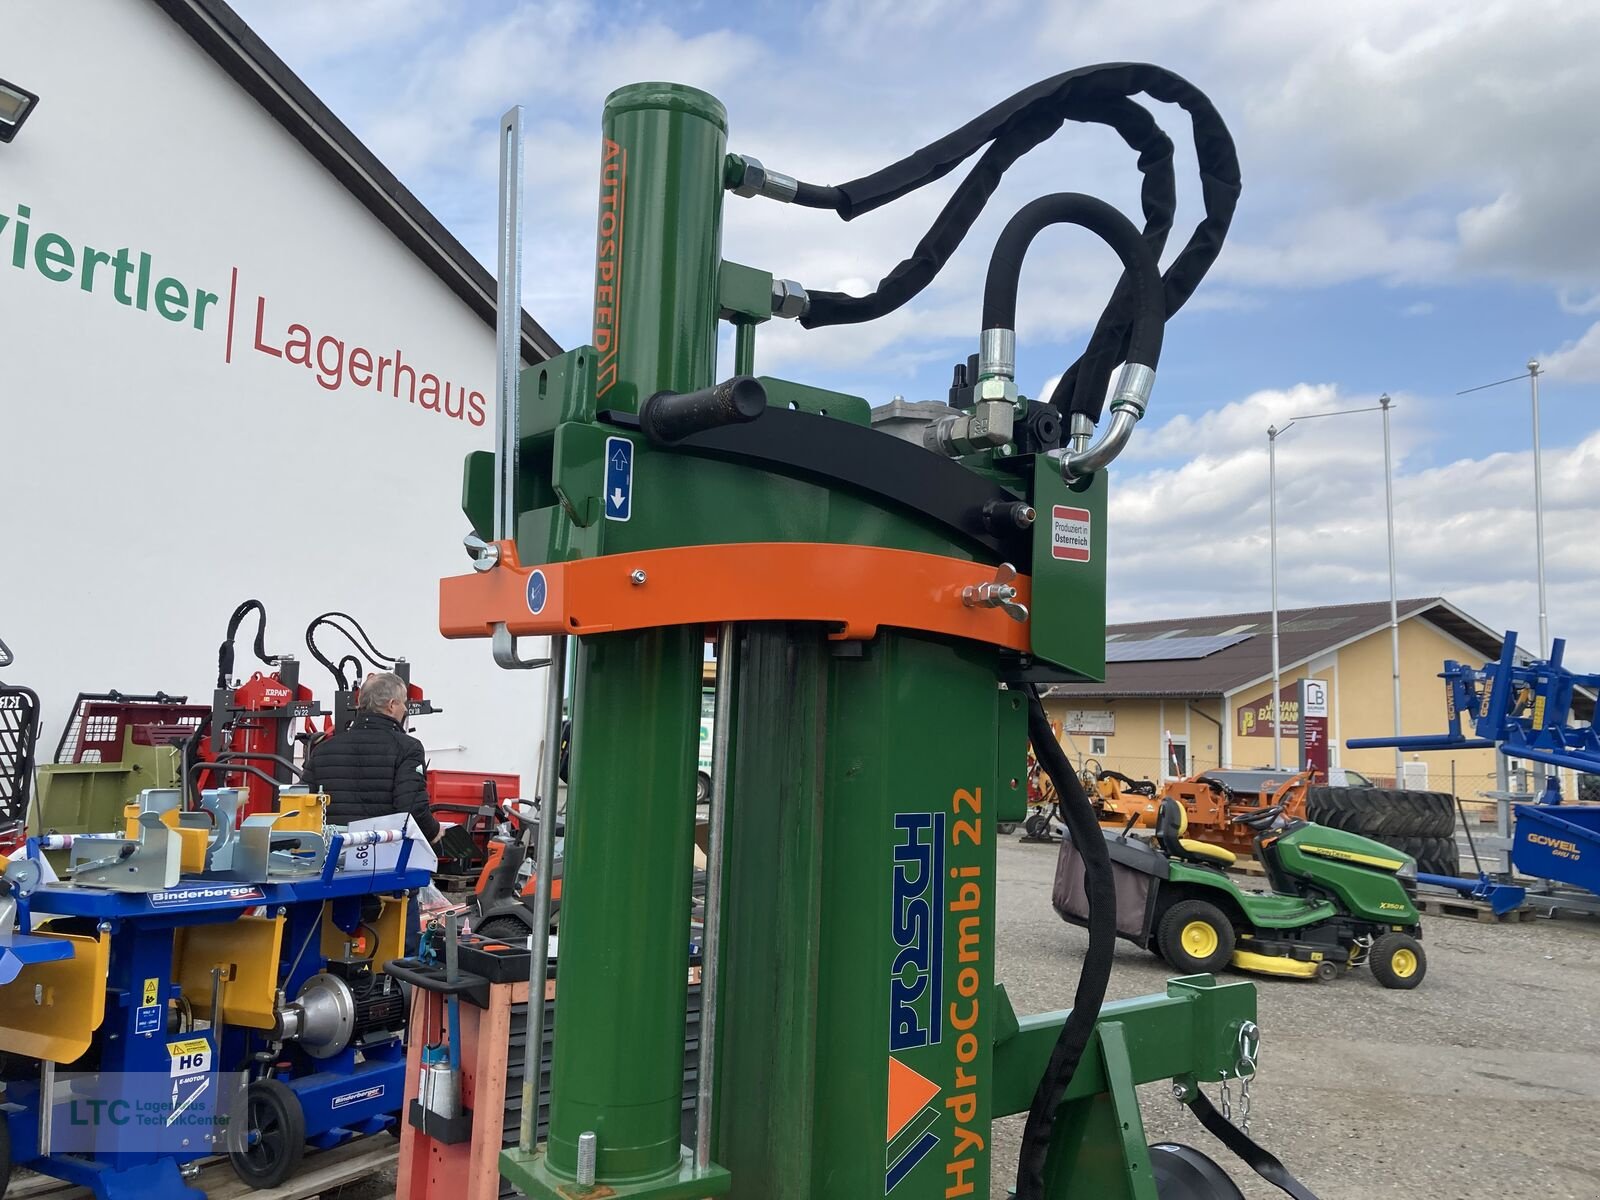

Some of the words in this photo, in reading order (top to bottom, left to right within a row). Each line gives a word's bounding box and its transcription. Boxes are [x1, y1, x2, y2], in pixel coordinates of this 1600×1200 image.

[594, 138, 620, 353] AUTOSPEED
[0, 203, 219, 331] iertler
[254, 296, 486, 427] Lagerhaus
[1055, 521, 1082, 535] Produziert
[265, 688, 288, 697] KRPAN
[952, 787, 982, 847] 22
[152, 887, 256, 901] Binderberger
[888, 812, 932, 1053] POSCH
[945, 866, 985, 1200] HydroCombi
[179, 1053, 204, 1071] H6
[179, 1075, 205, 1085] E-MOTOR
[335, 1088, 380, 1104] Binderberger
